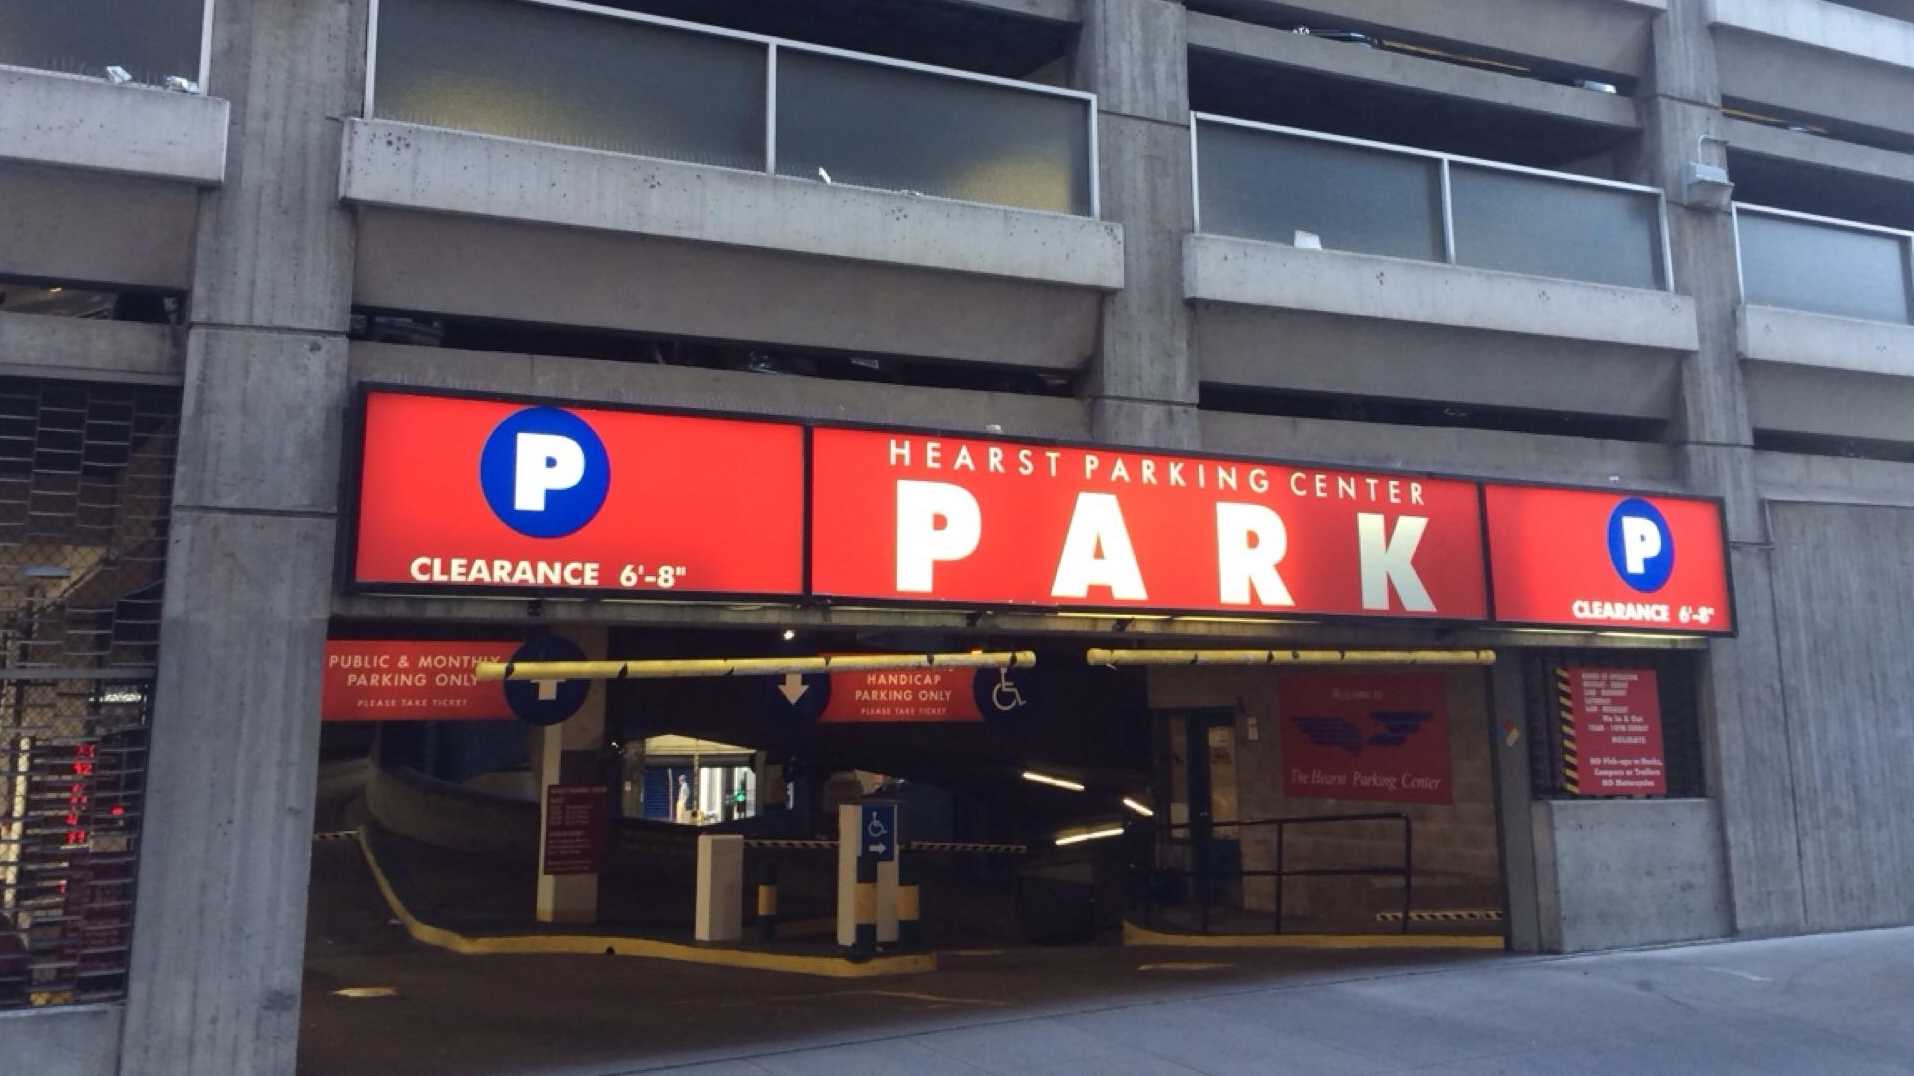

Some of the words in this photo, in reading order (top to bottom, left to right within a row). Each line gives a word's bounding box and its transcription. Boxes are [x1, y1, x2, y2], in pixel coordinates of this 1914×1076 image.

[514, 432, 586, 511] P
[890, 440, 1060, 477] HEARST
[1085, 455, 1269, 494] PARKING
[1290, 472, 1426, 505] CENTER
[896, 479, 1438, 612] PARK
[1621, 515, 1662, 574] P
[410, 557, 600, 586] CLEARANCE
[620, 565, 686, 588] 6'-8"
[1572, 600, 1669, 623] CLEARANCE
[329, 655, 390, 668] PUBLIC
[398, 655, 409, 668] &
[347, 674, 427, 687] PARKING
[435, 673, 477, 687] ONLY
[866, 673, 942, 686] HANDICAP
[357, 699, 396, 707] PLEASE
[402, 699, 427, 707] TAKE
[432, 699, 468, 707] TICKET
[855, 689, 913, 701] PARKING
[918, 689, 952, 702] ONLY
[1352, 770, 1397, 791] Parking
[1401, 773, 1441, 790] Center
